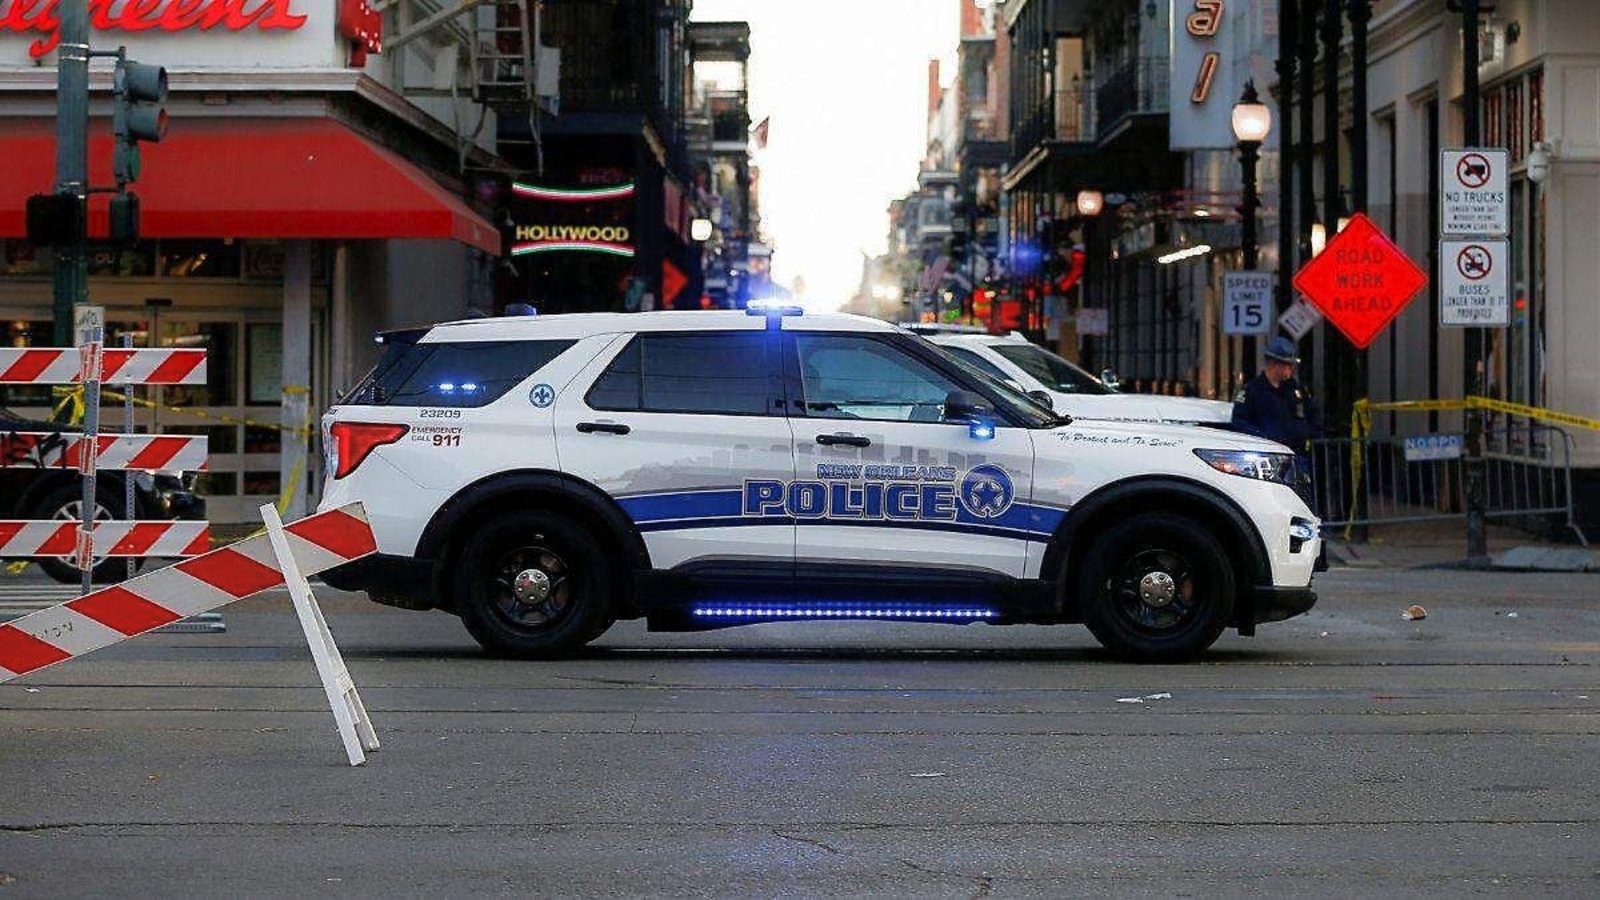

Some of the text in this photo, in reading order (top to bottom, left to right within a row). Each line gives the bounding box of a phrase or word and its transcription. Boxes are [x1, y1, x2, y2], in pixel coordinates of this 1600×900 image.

[1446, 192, 1504, 203] NO TRUCKS
[516, 225, 629, 241] HOLLYWOOD
[1336, 248, 1384, 265] ROAD
[1227, 278, 1268, 289] SPEED
[1337, 273, 1384, 289] WORK
[1231, 291, 1264, 302] LIMIT
[1459, 285, 1490, 295] BUSES
[1332, 296, 1392, 312] AHEAD
[1232, 305, 1264, 328] 15
[420, 409, 461, 418] 23209
[411, 426, 462, 434] EMERGENCY
[433, 434, 461, 447] 911
[1074, 432, 1109, 444] Protect
[1111, 436, 1131, 444] and
[1133, 436, 1145, 445] To
[816, 463, 957, 482] NEW ORLEANS
[743, 478, 959, 522] POLICE
